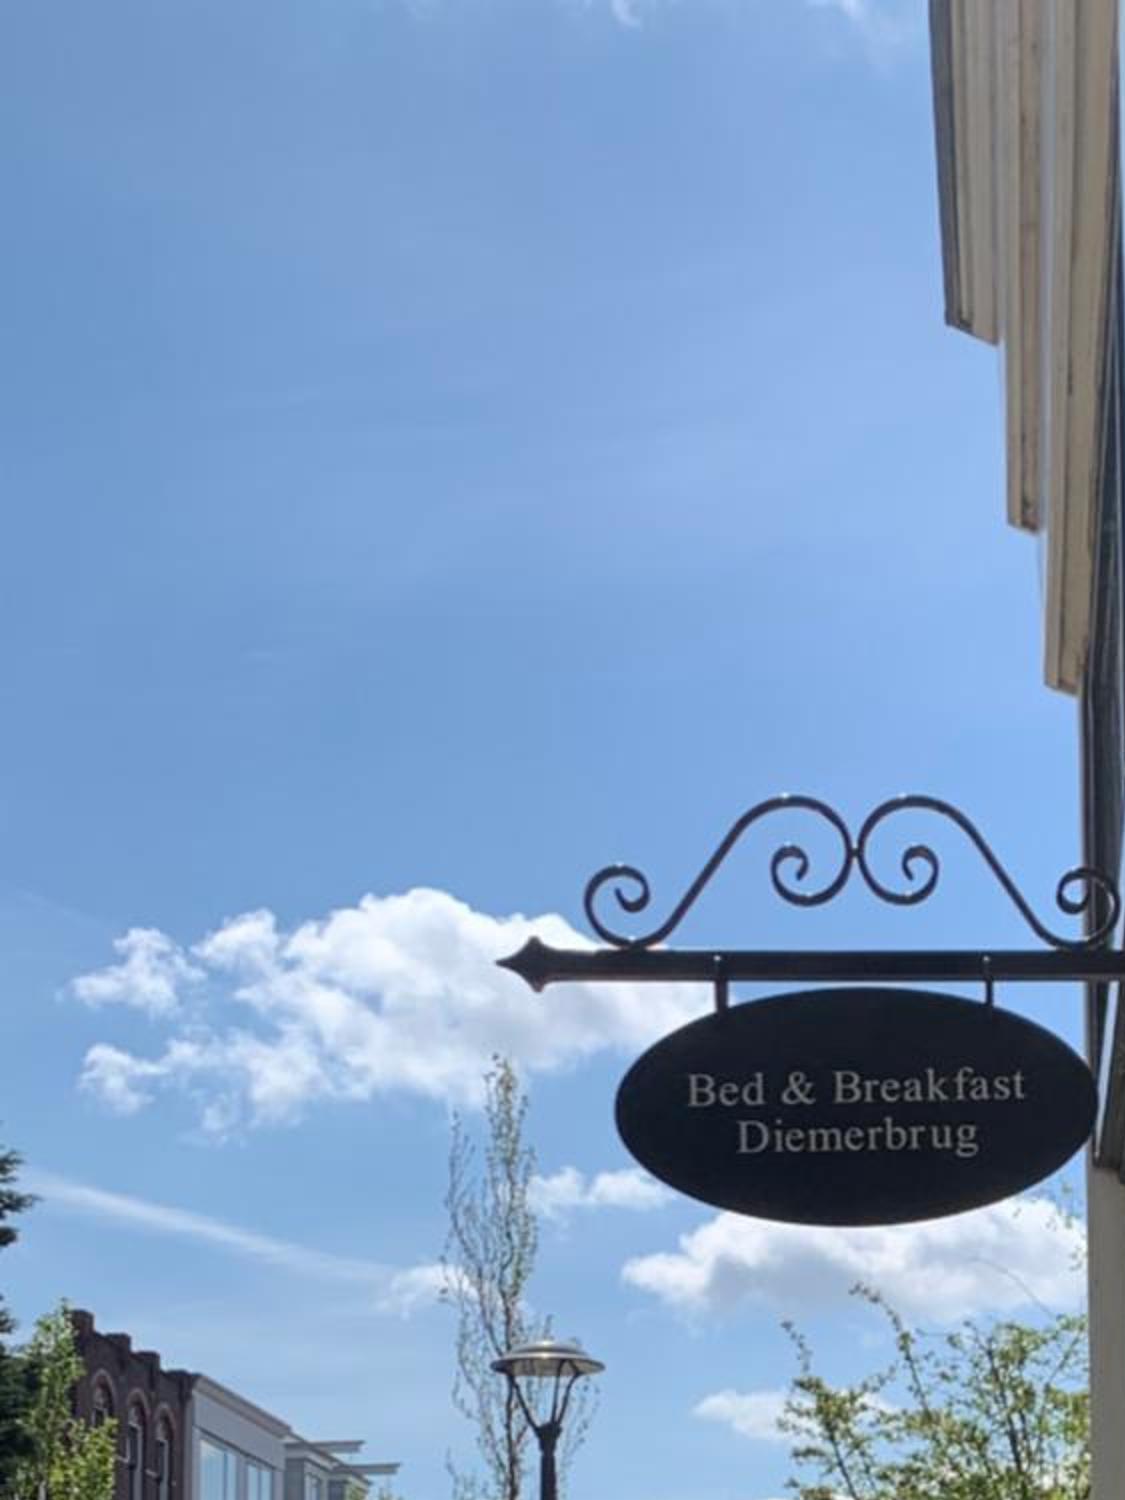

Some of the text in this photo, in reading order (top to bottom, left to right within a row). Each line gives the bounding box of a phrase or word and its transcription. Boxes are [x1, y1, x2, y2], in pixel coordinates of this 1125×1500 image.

[688, 1066, 1025, 1107] Bed & Breakfast
[736, 1116, 980, 1158] Diemerbrug
